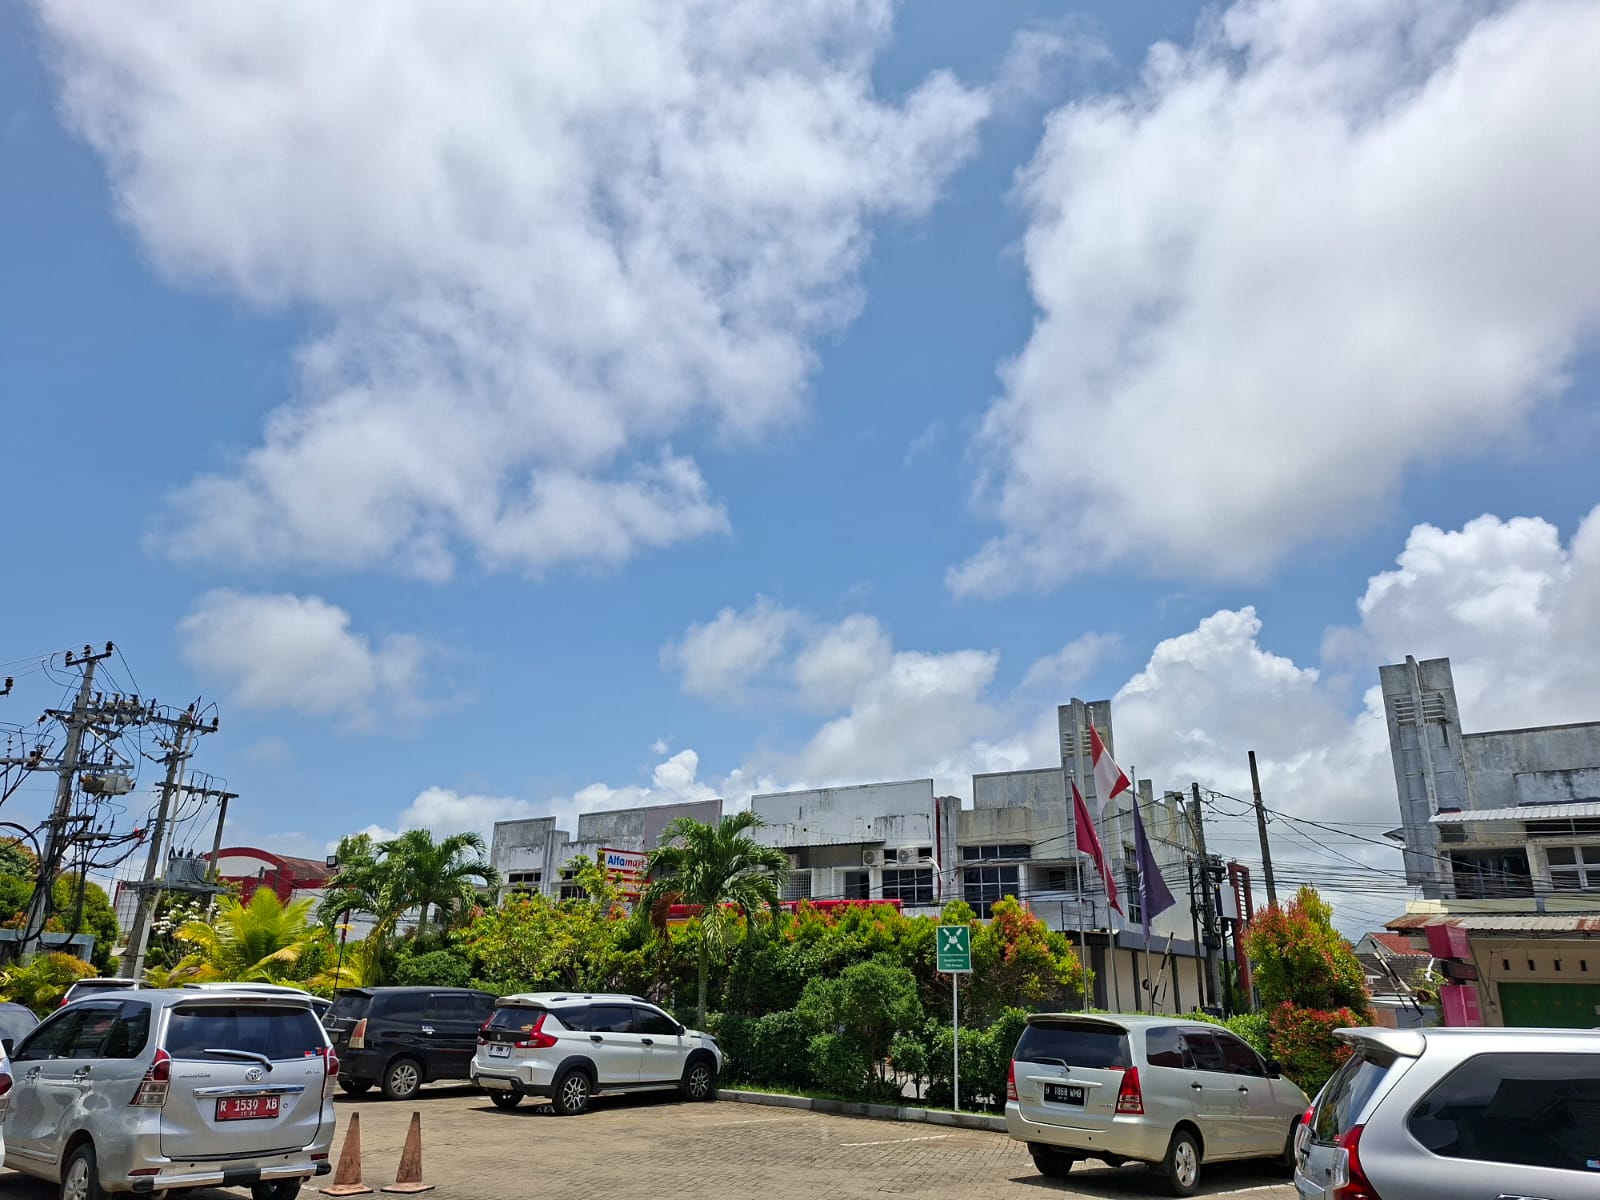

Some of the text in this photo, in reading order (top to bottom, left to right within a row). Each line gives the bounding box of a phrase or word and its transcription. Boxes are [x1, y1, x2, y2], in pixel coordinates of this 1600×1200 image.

[220, 1098, 278, 1112] R 1539 XB
